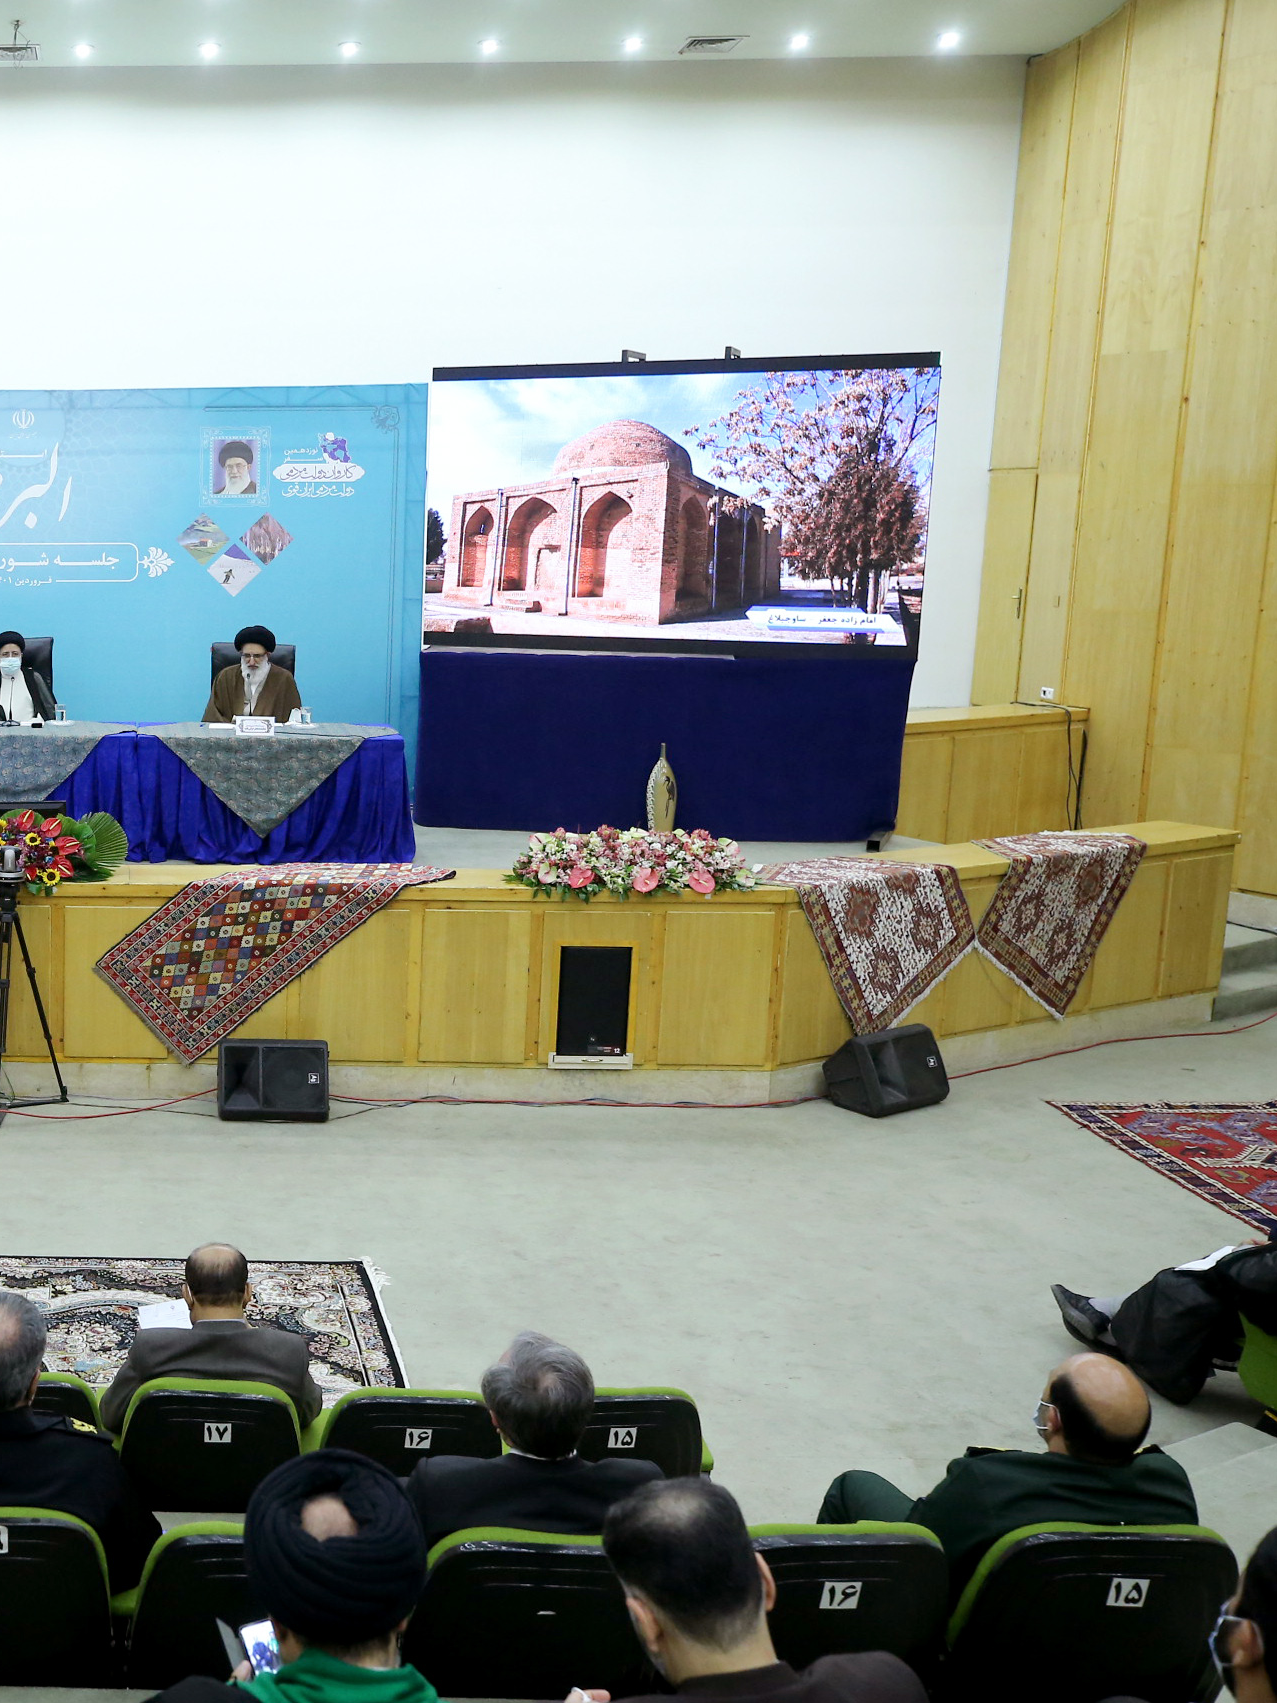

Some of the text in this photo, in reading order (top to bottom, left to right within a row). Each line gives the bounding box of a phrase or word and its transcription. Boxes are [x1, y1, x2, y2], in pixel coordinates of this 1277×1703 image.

[284, 447, 319, 455] نوزدهمین
[280, 465, 357, 481] کاروان دولت مردمی
[282, 482, 355, 498] دولت مردمی ایران قوی
[53, 552, 120, 569] جلسه
[14, 576, 52, 586] فروردین
[859, 616, 876, 625] امام
[206, 1425, 228, 1440] ۱۷
[408, 1431, 430, 1447] ۱۶
[613, 1430, 633, 1446] ۱۵
[828, 1584, 857, 1607] ۱۶
[1114, 1581, 1143, 1604] ۱۵
